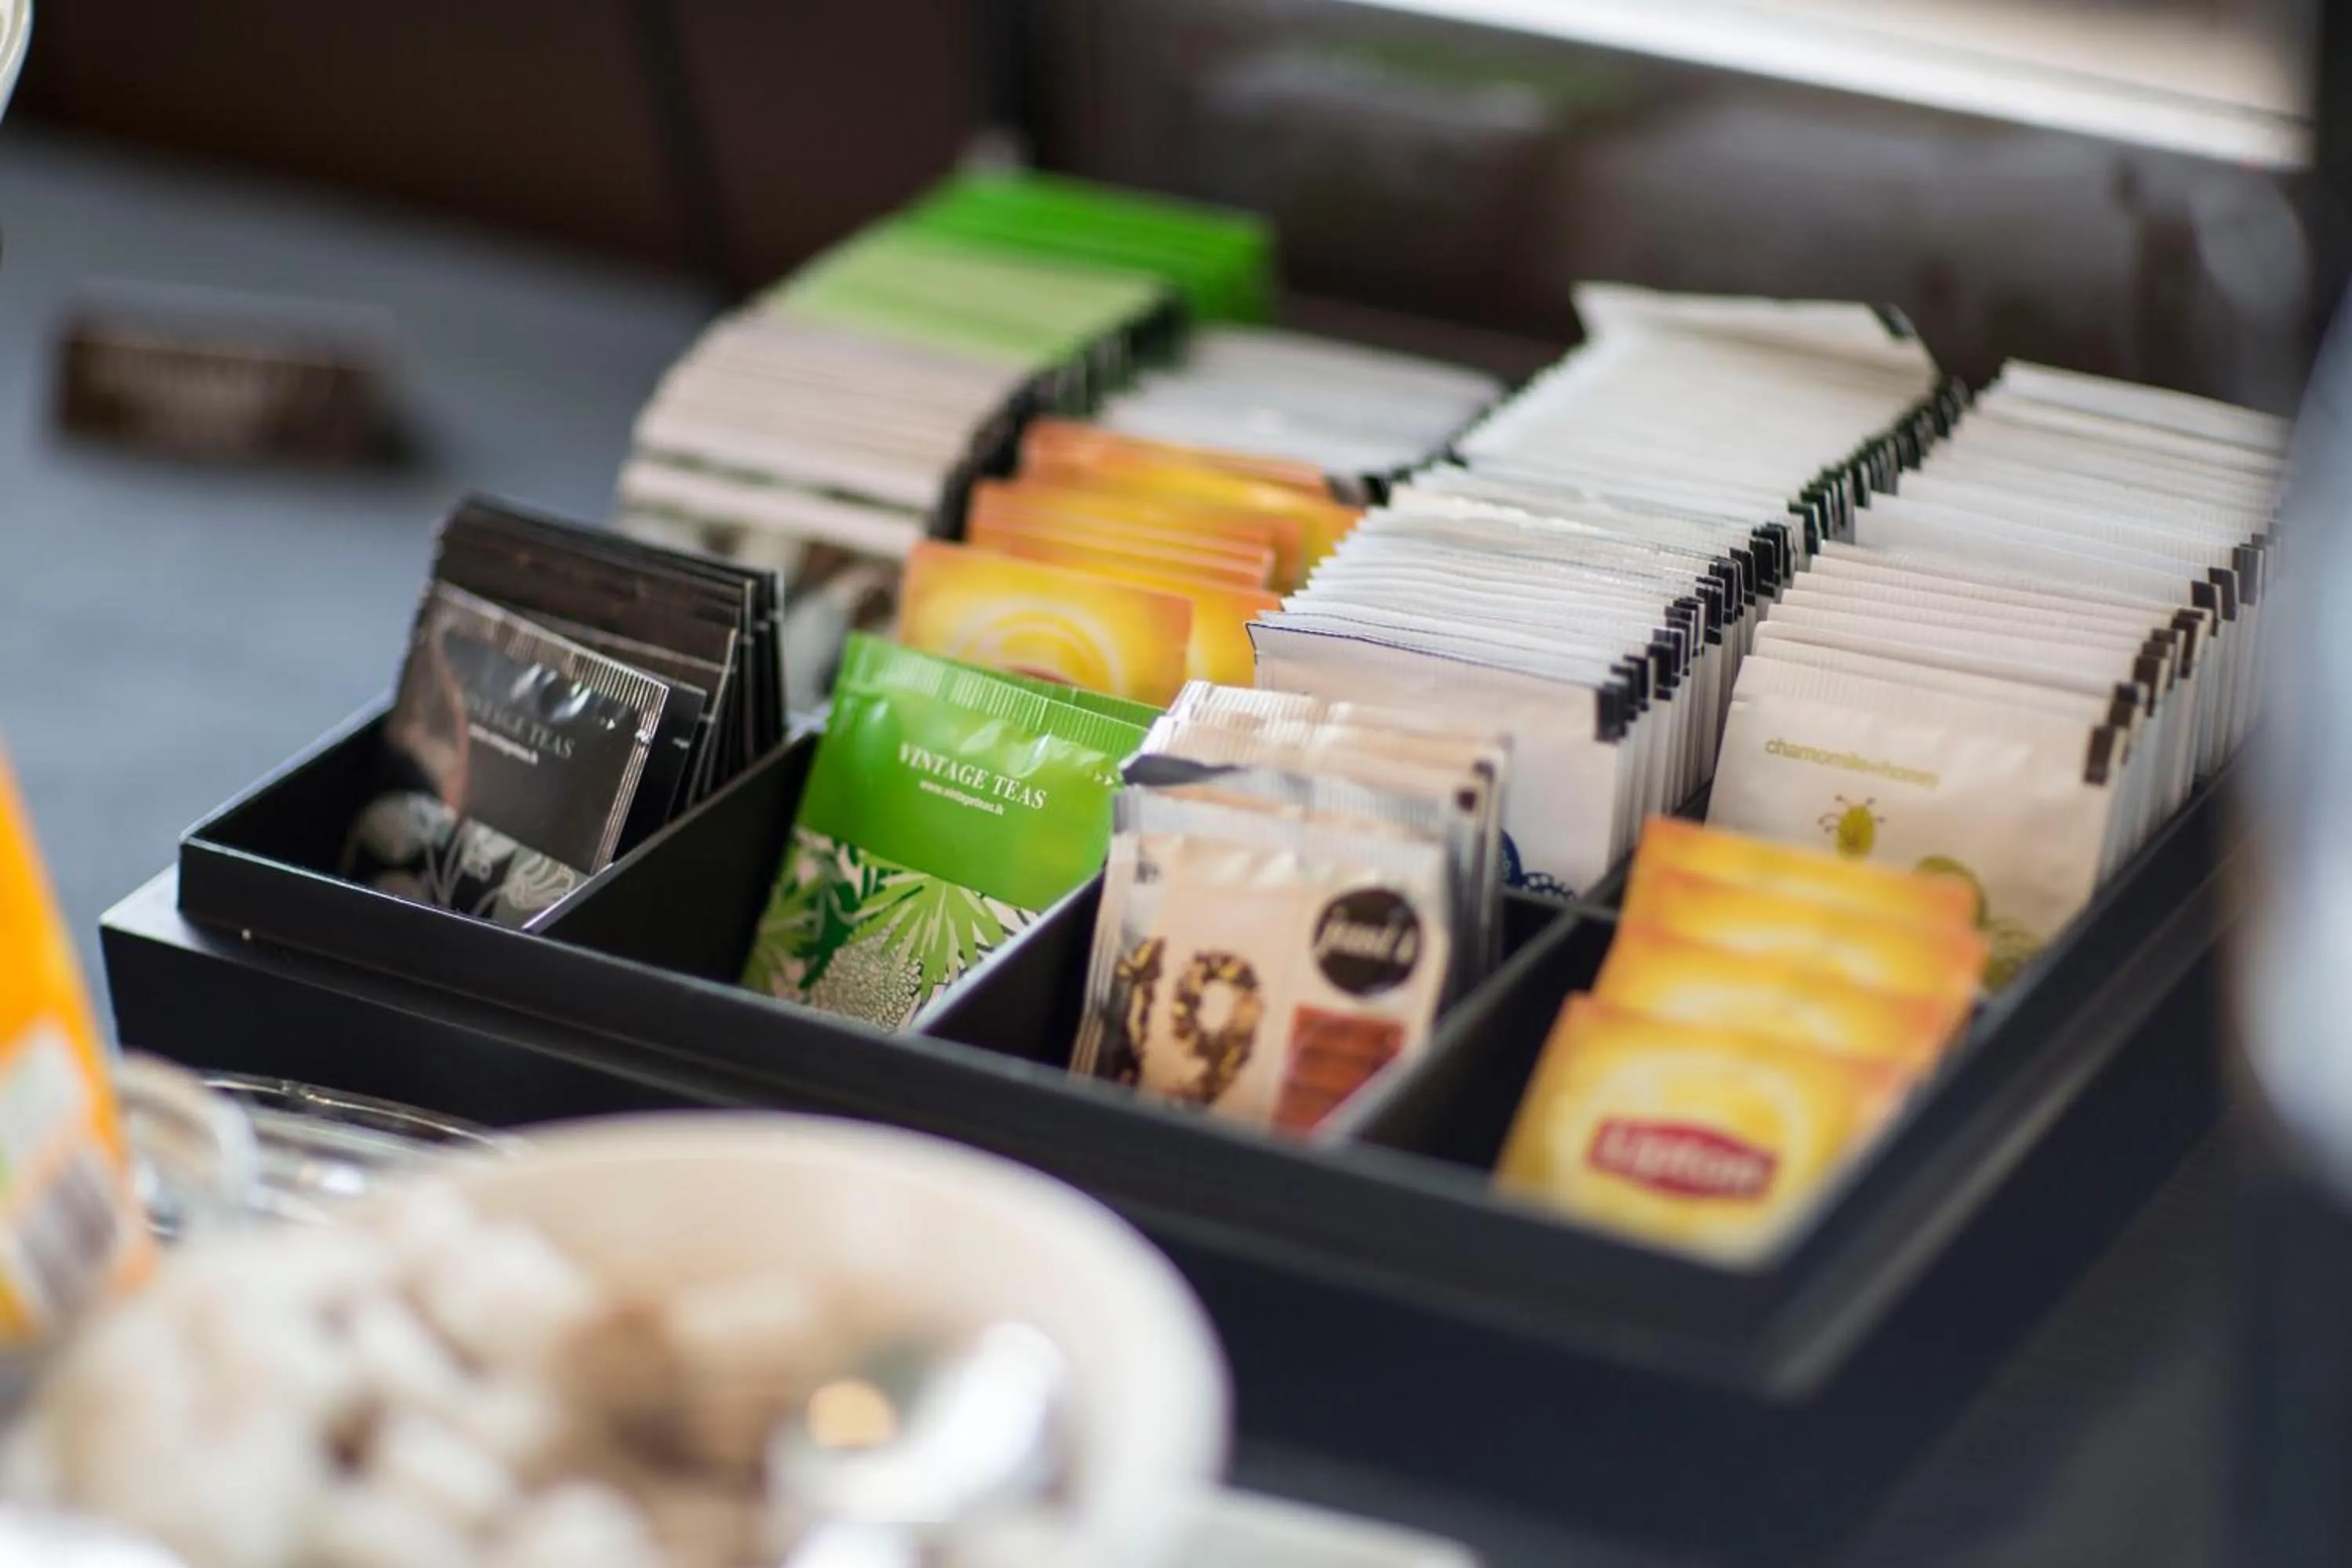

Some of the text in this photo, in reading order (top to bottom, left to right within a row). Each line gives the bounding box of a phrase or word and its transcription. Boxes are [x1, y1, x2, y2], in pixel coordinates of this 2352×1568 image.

[898, 742, 1047, 811] VINTAGE TEAS
[1601, 1123, 1766, 1190] Lipton
